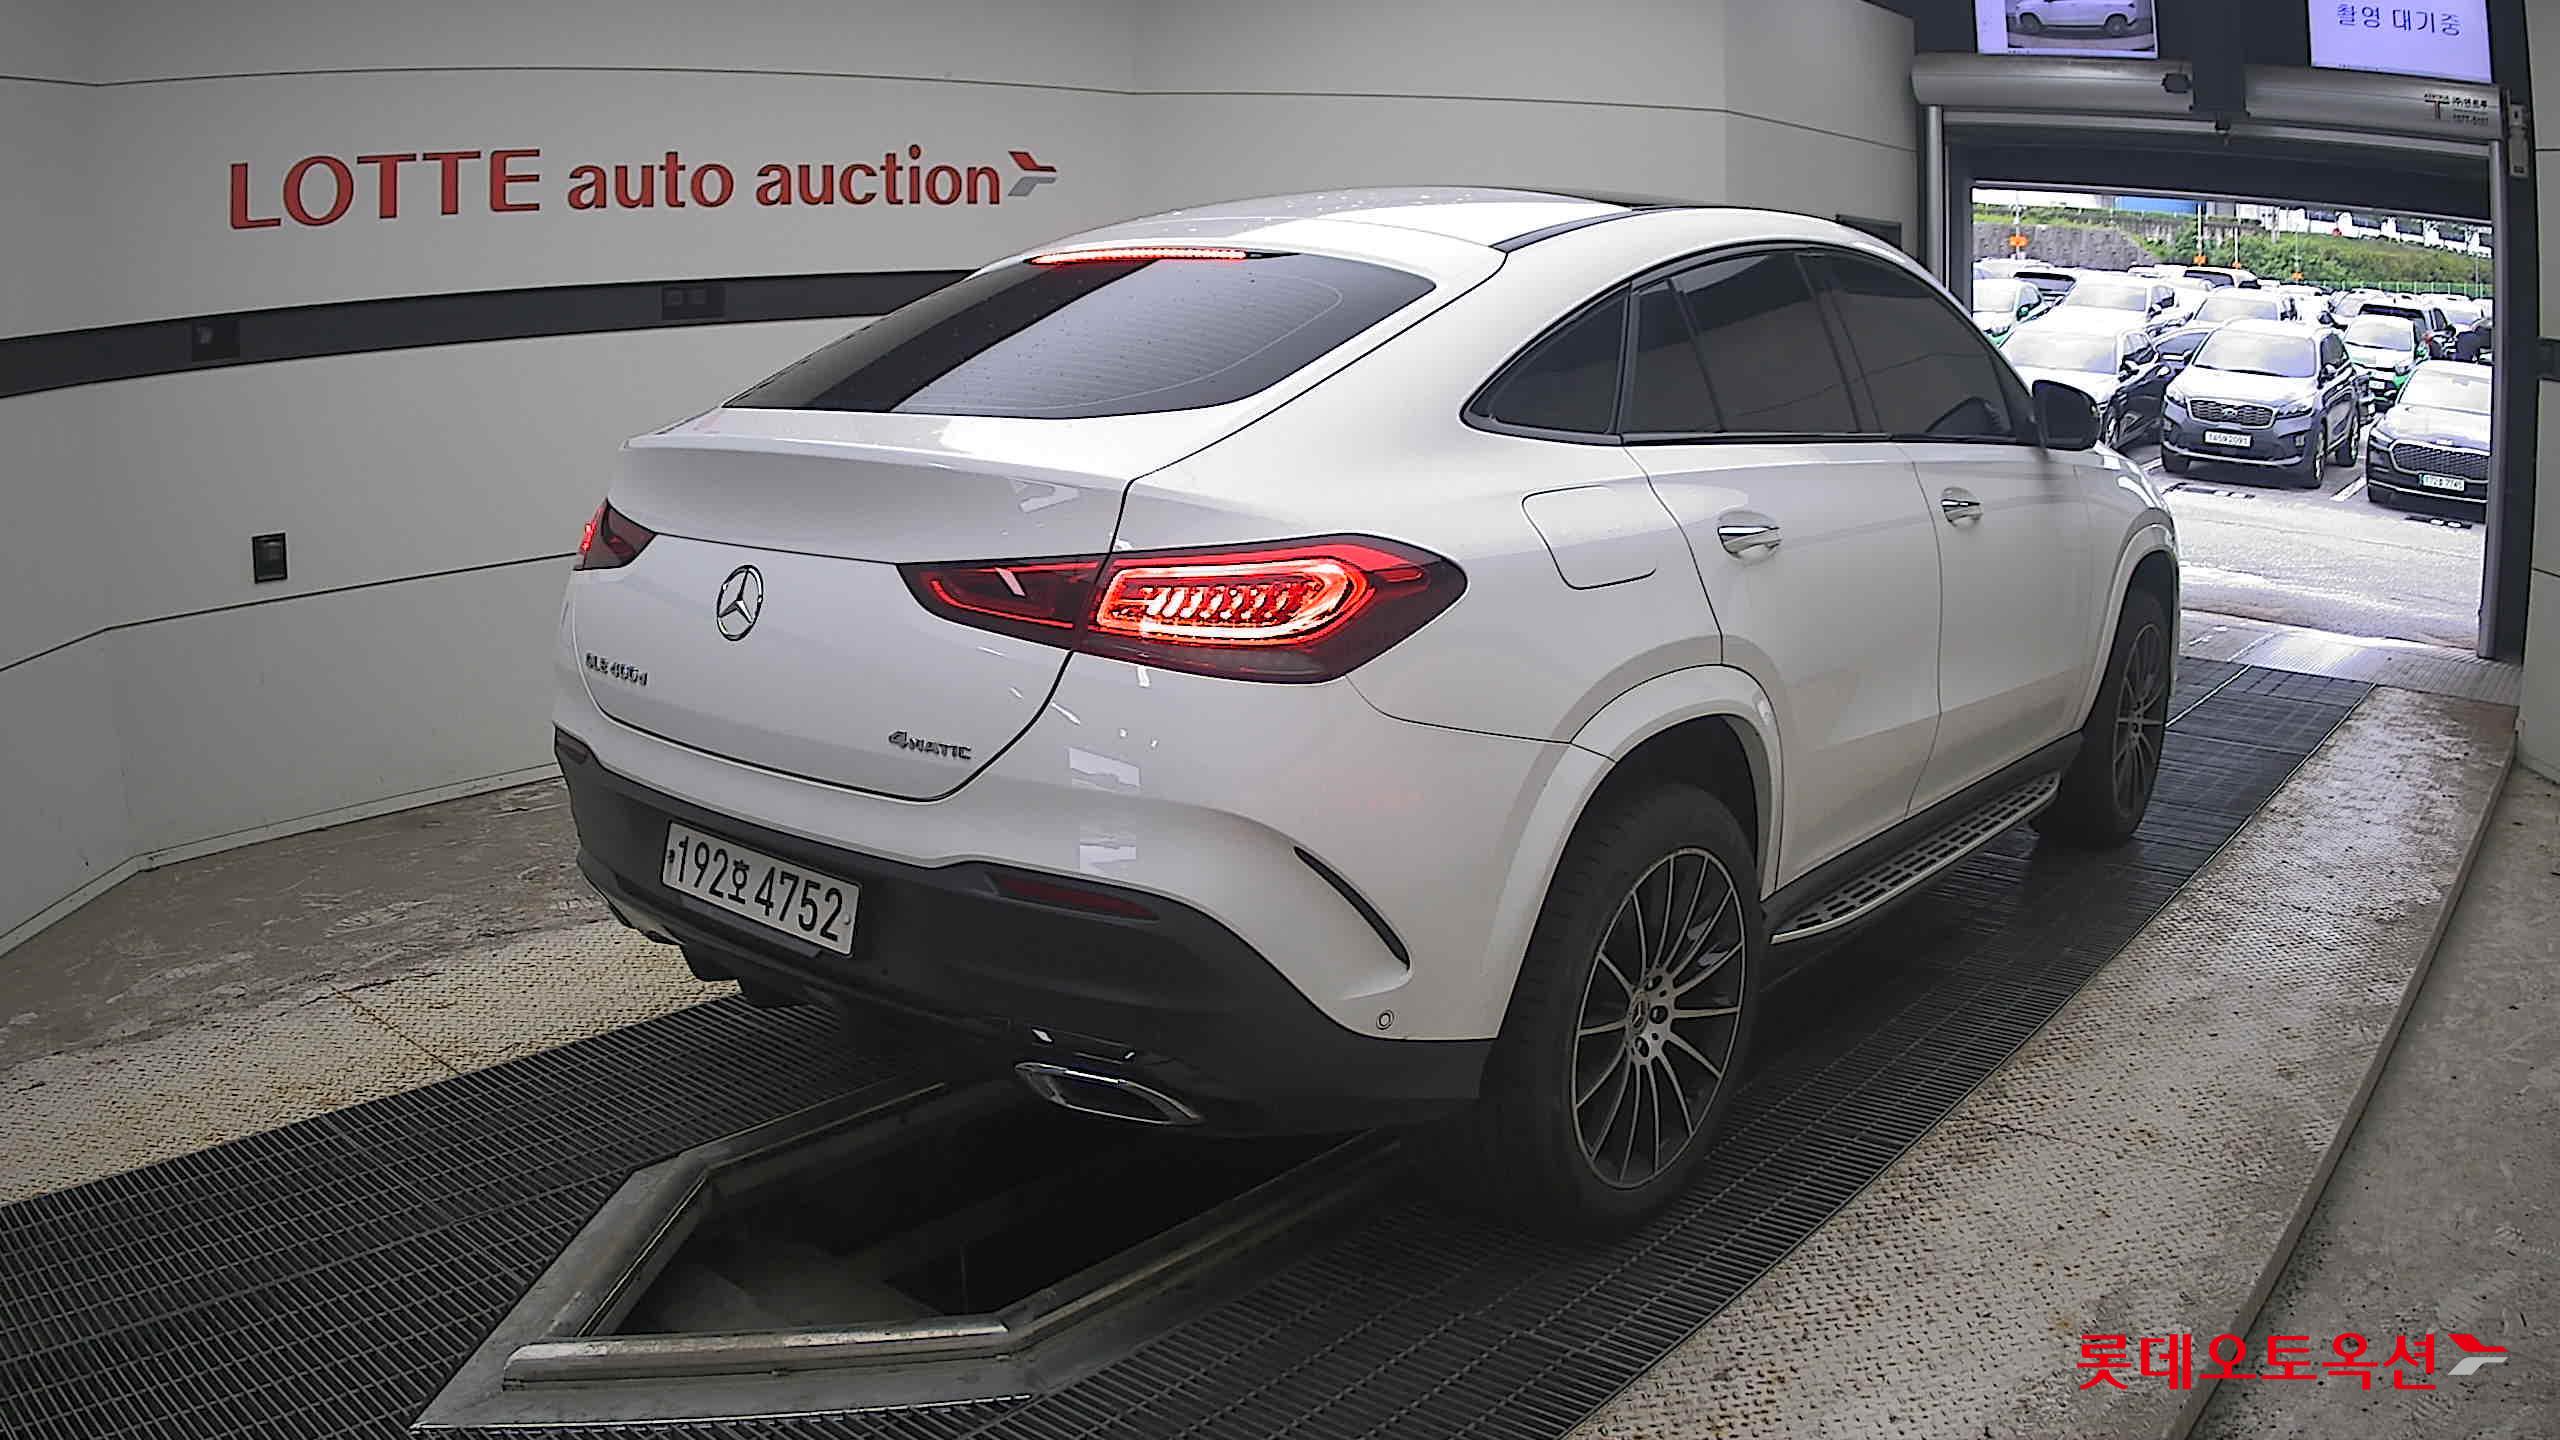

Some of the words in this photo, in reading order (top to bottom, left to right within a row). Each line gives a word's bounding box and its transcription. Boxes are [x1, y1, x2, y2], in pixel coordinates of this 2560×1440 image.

[2337, 3, 2381, 29] 촬영
[2392, 9, 2460, 37] 대기중
[230, 149, 541, 231] LOTTE
[567, 152, 734, 209] auto
[756, 145, 1001, 206] auction
